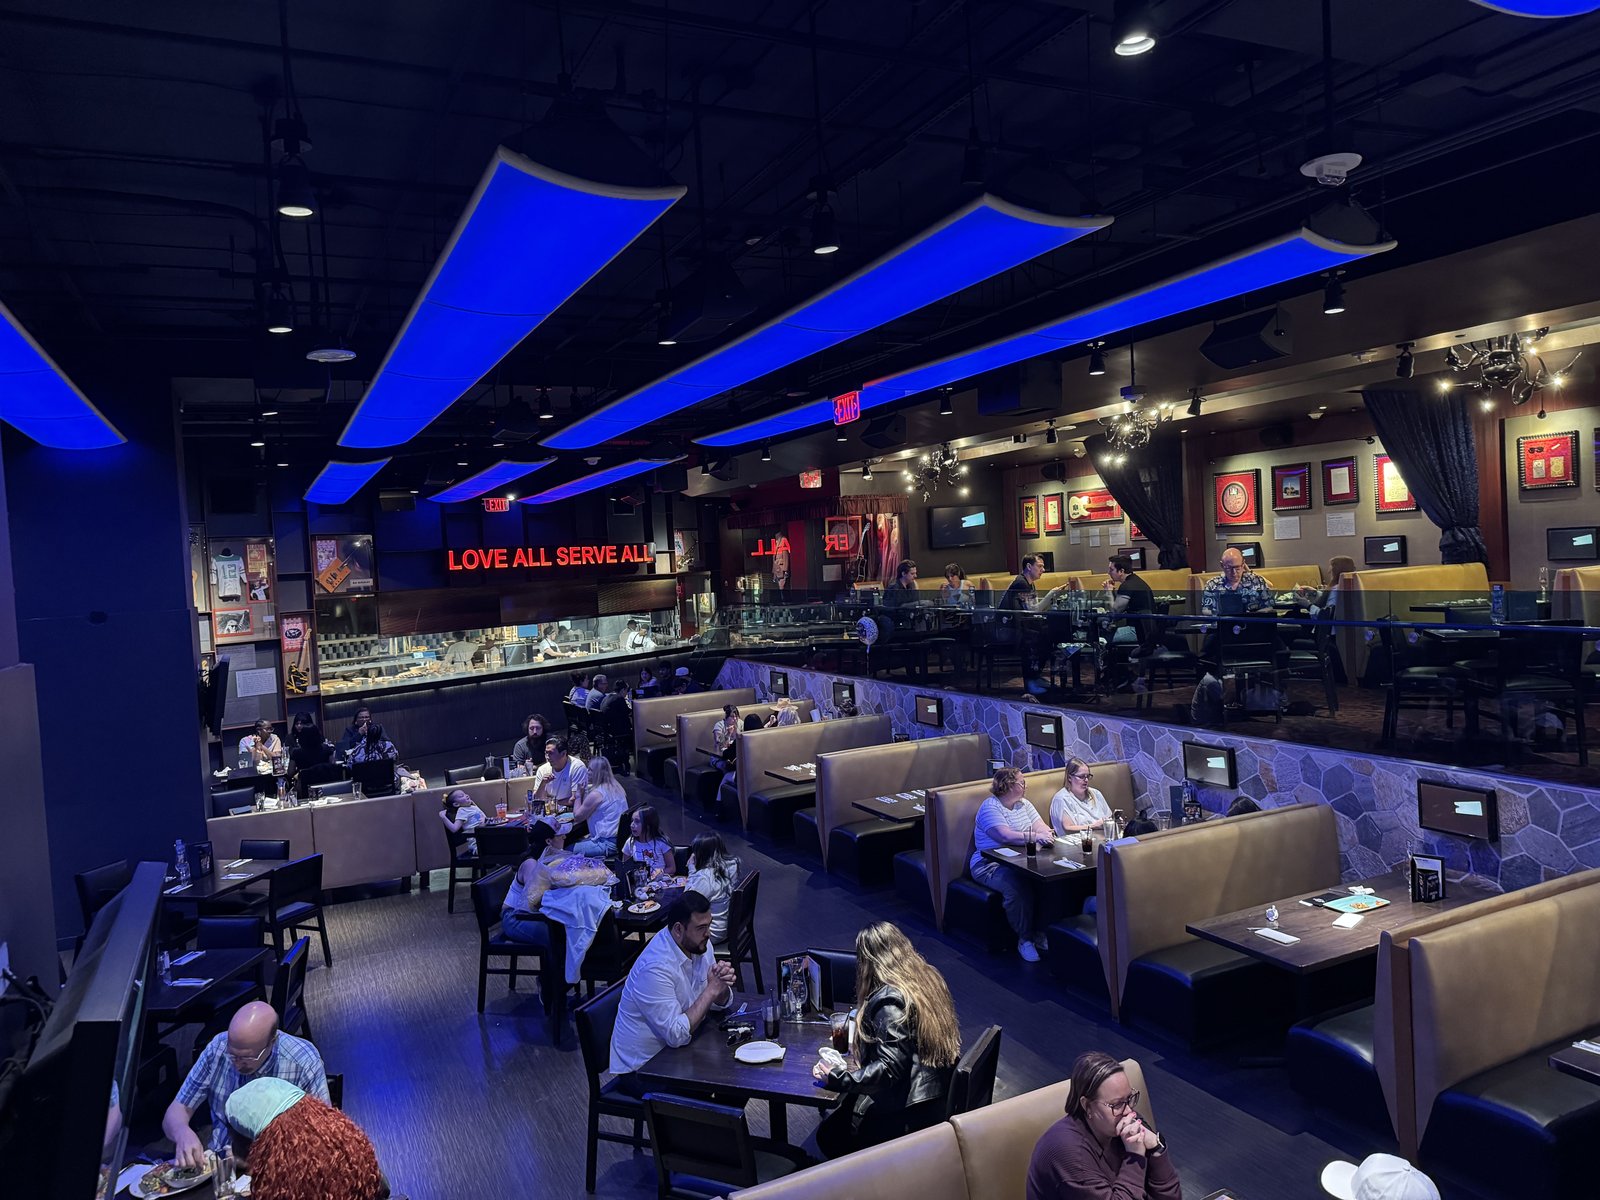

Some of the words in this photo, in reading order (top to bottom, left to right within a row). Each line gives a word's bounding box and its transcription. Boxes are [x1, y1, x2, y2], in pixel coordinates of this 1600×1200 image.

[836, 395, 855, 422] EXIT
[490, 499, 506, 512] EXIT
[448, 548, 508, 570] LOVE
[513, 547, 552, 568] ALL
[556, 545, 618, 566] SERVE
[621, 544, 653, 563] ALL
[222, 563, 237, 579] 12
